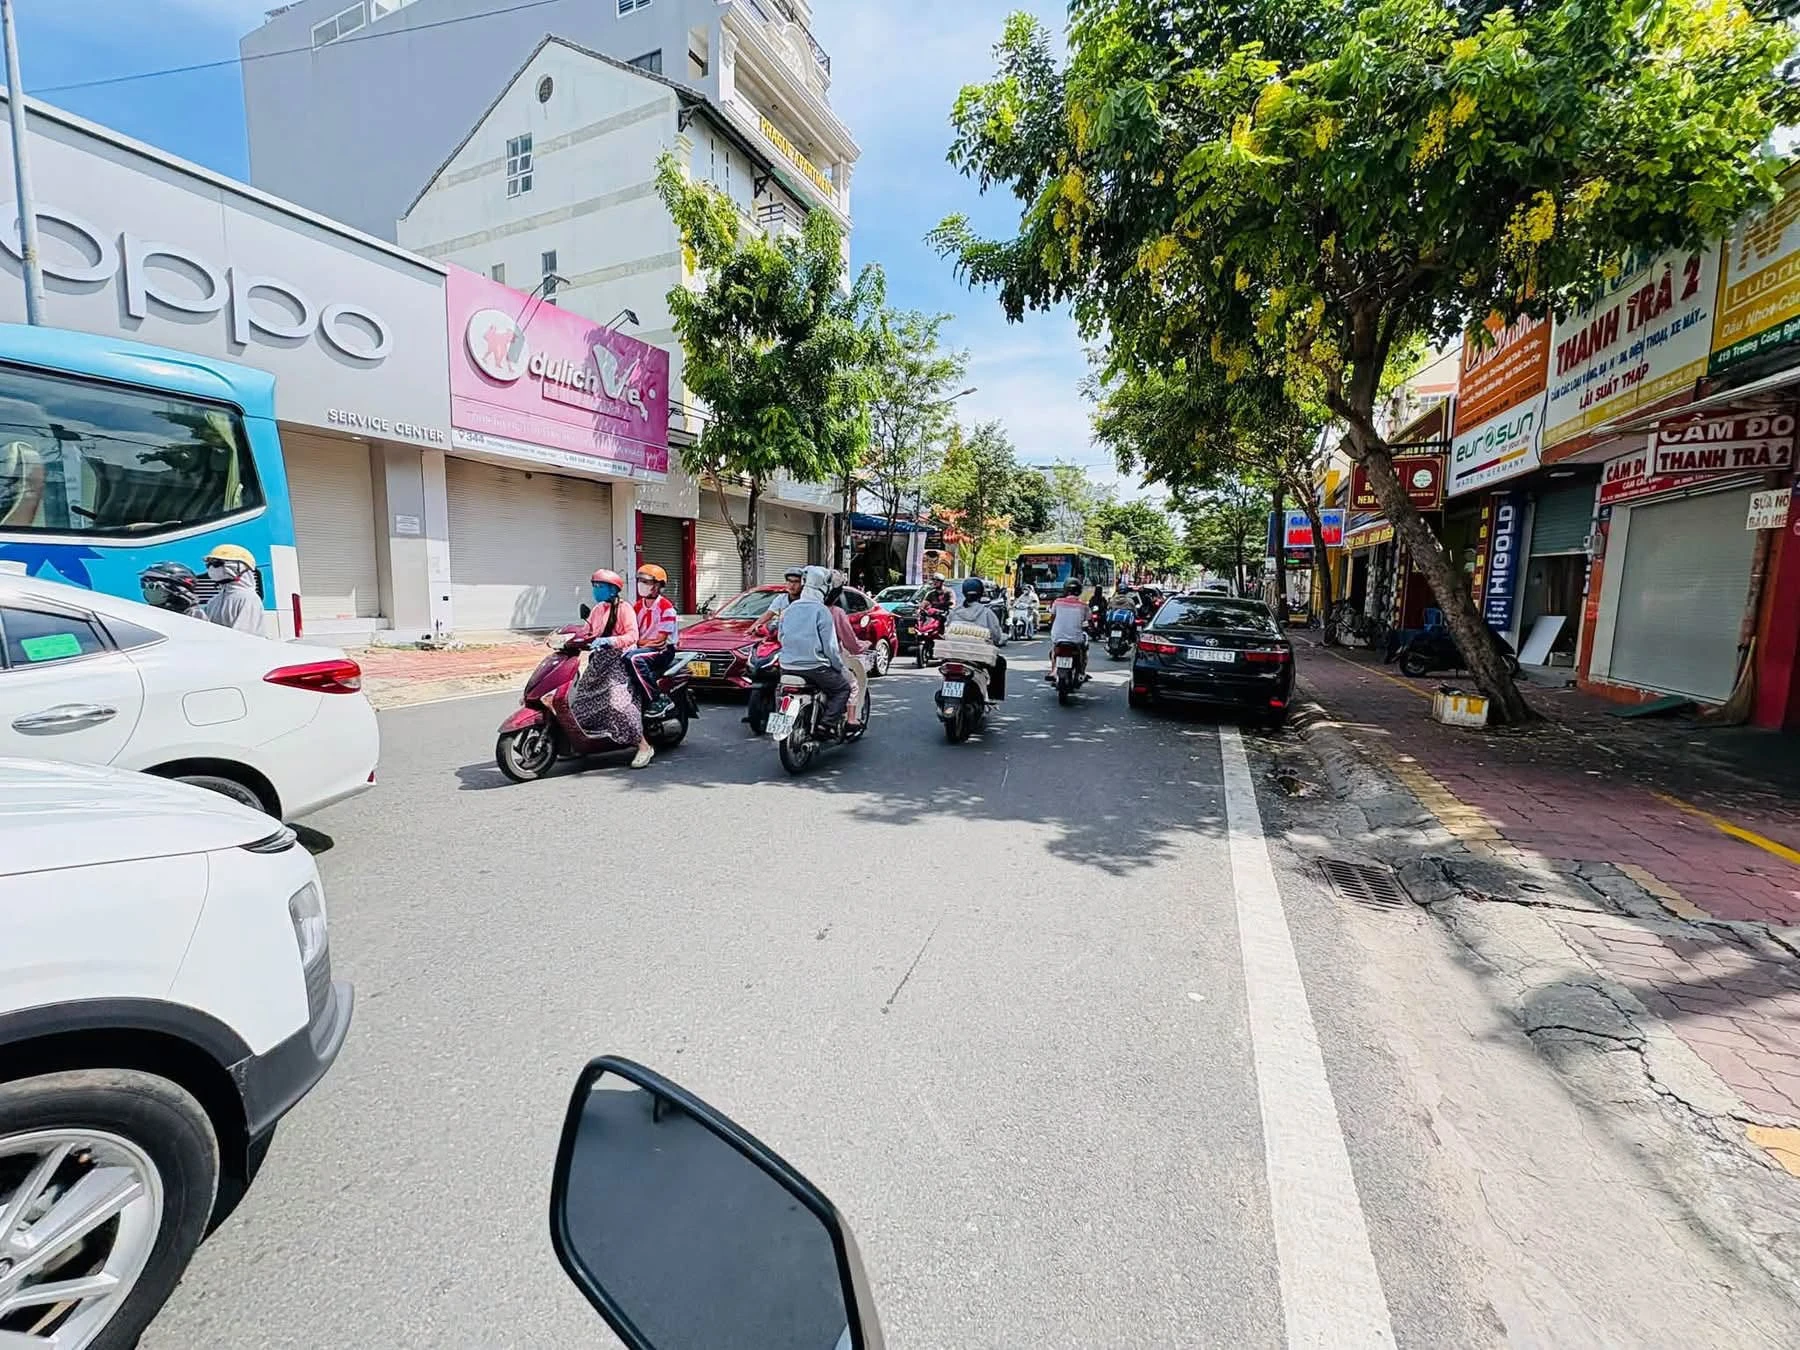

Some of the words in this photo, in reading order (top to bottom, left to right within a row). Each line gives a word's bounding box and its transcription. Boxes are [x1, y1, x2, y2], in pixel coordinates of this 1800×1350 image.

[1557, 304, 1619, 376] THANH
[1681, 253, 1700, 300] 2
[1670, 320, 1681, 336] XE
[328, 408, 389, 432] SERVICE
[395, 422, 445, 444] CENTER
[1658, 412, 1734, 443] CẦM
[1660, 448, 1727, 470] THANH
[1733, 442, 1771, 466] TRÀ
[1775, 445, 1789, 465] 2
[1489, 505, 1513, 594] HIGOLD
